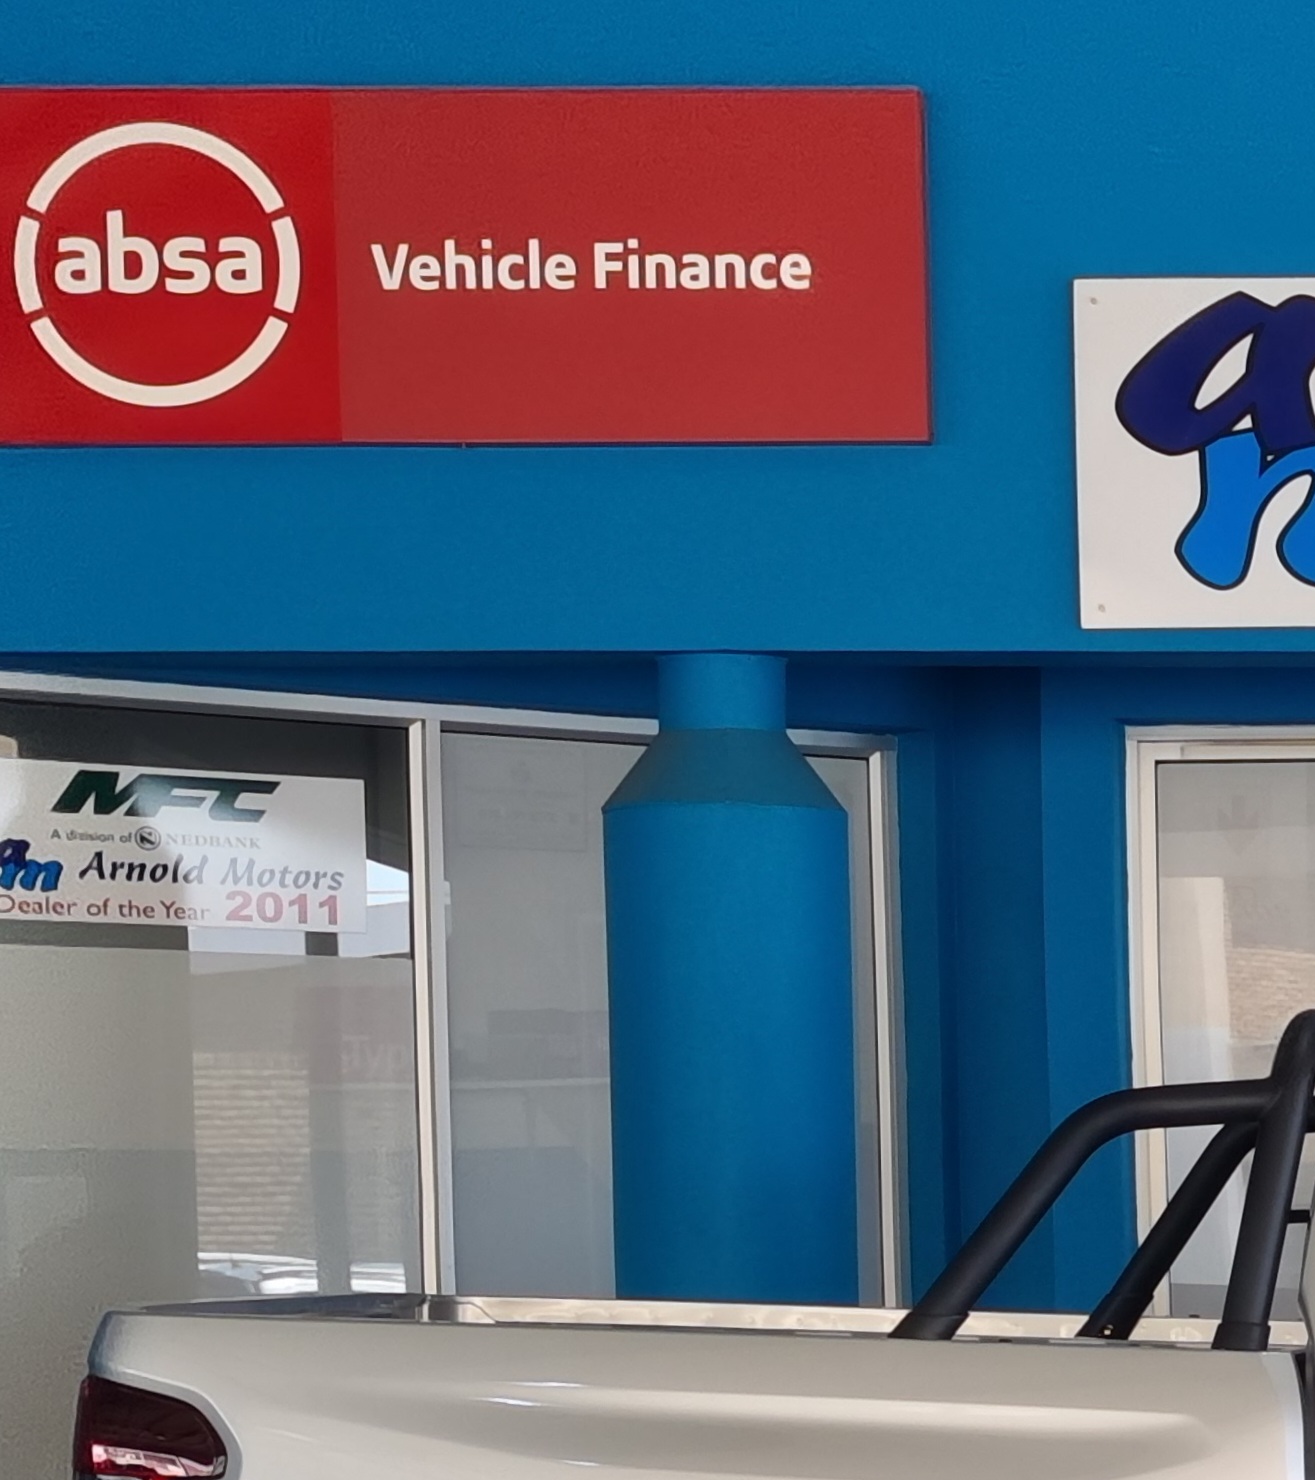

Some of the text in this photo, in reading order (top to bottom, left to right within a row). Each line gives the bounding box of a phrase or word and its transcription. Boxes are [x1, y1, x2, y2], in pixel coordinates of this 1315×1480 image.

[55, 210, 263, 294] absa
[371, 238, 812, 291] Vehicle Finance
[51, 770, 281, 822] MFC
[51, 828, 61, 840] A
[120, 832, 133, 843] of
[166, 833, 261, 849] NEDBANK
[79, 851, 344, 890] Arnold Motors
[87, 898, 110, 916] of
[119, 899, 155, 918] the
[160, 900, 211, 920] Year
[226, 891, 339, 926] 2011
